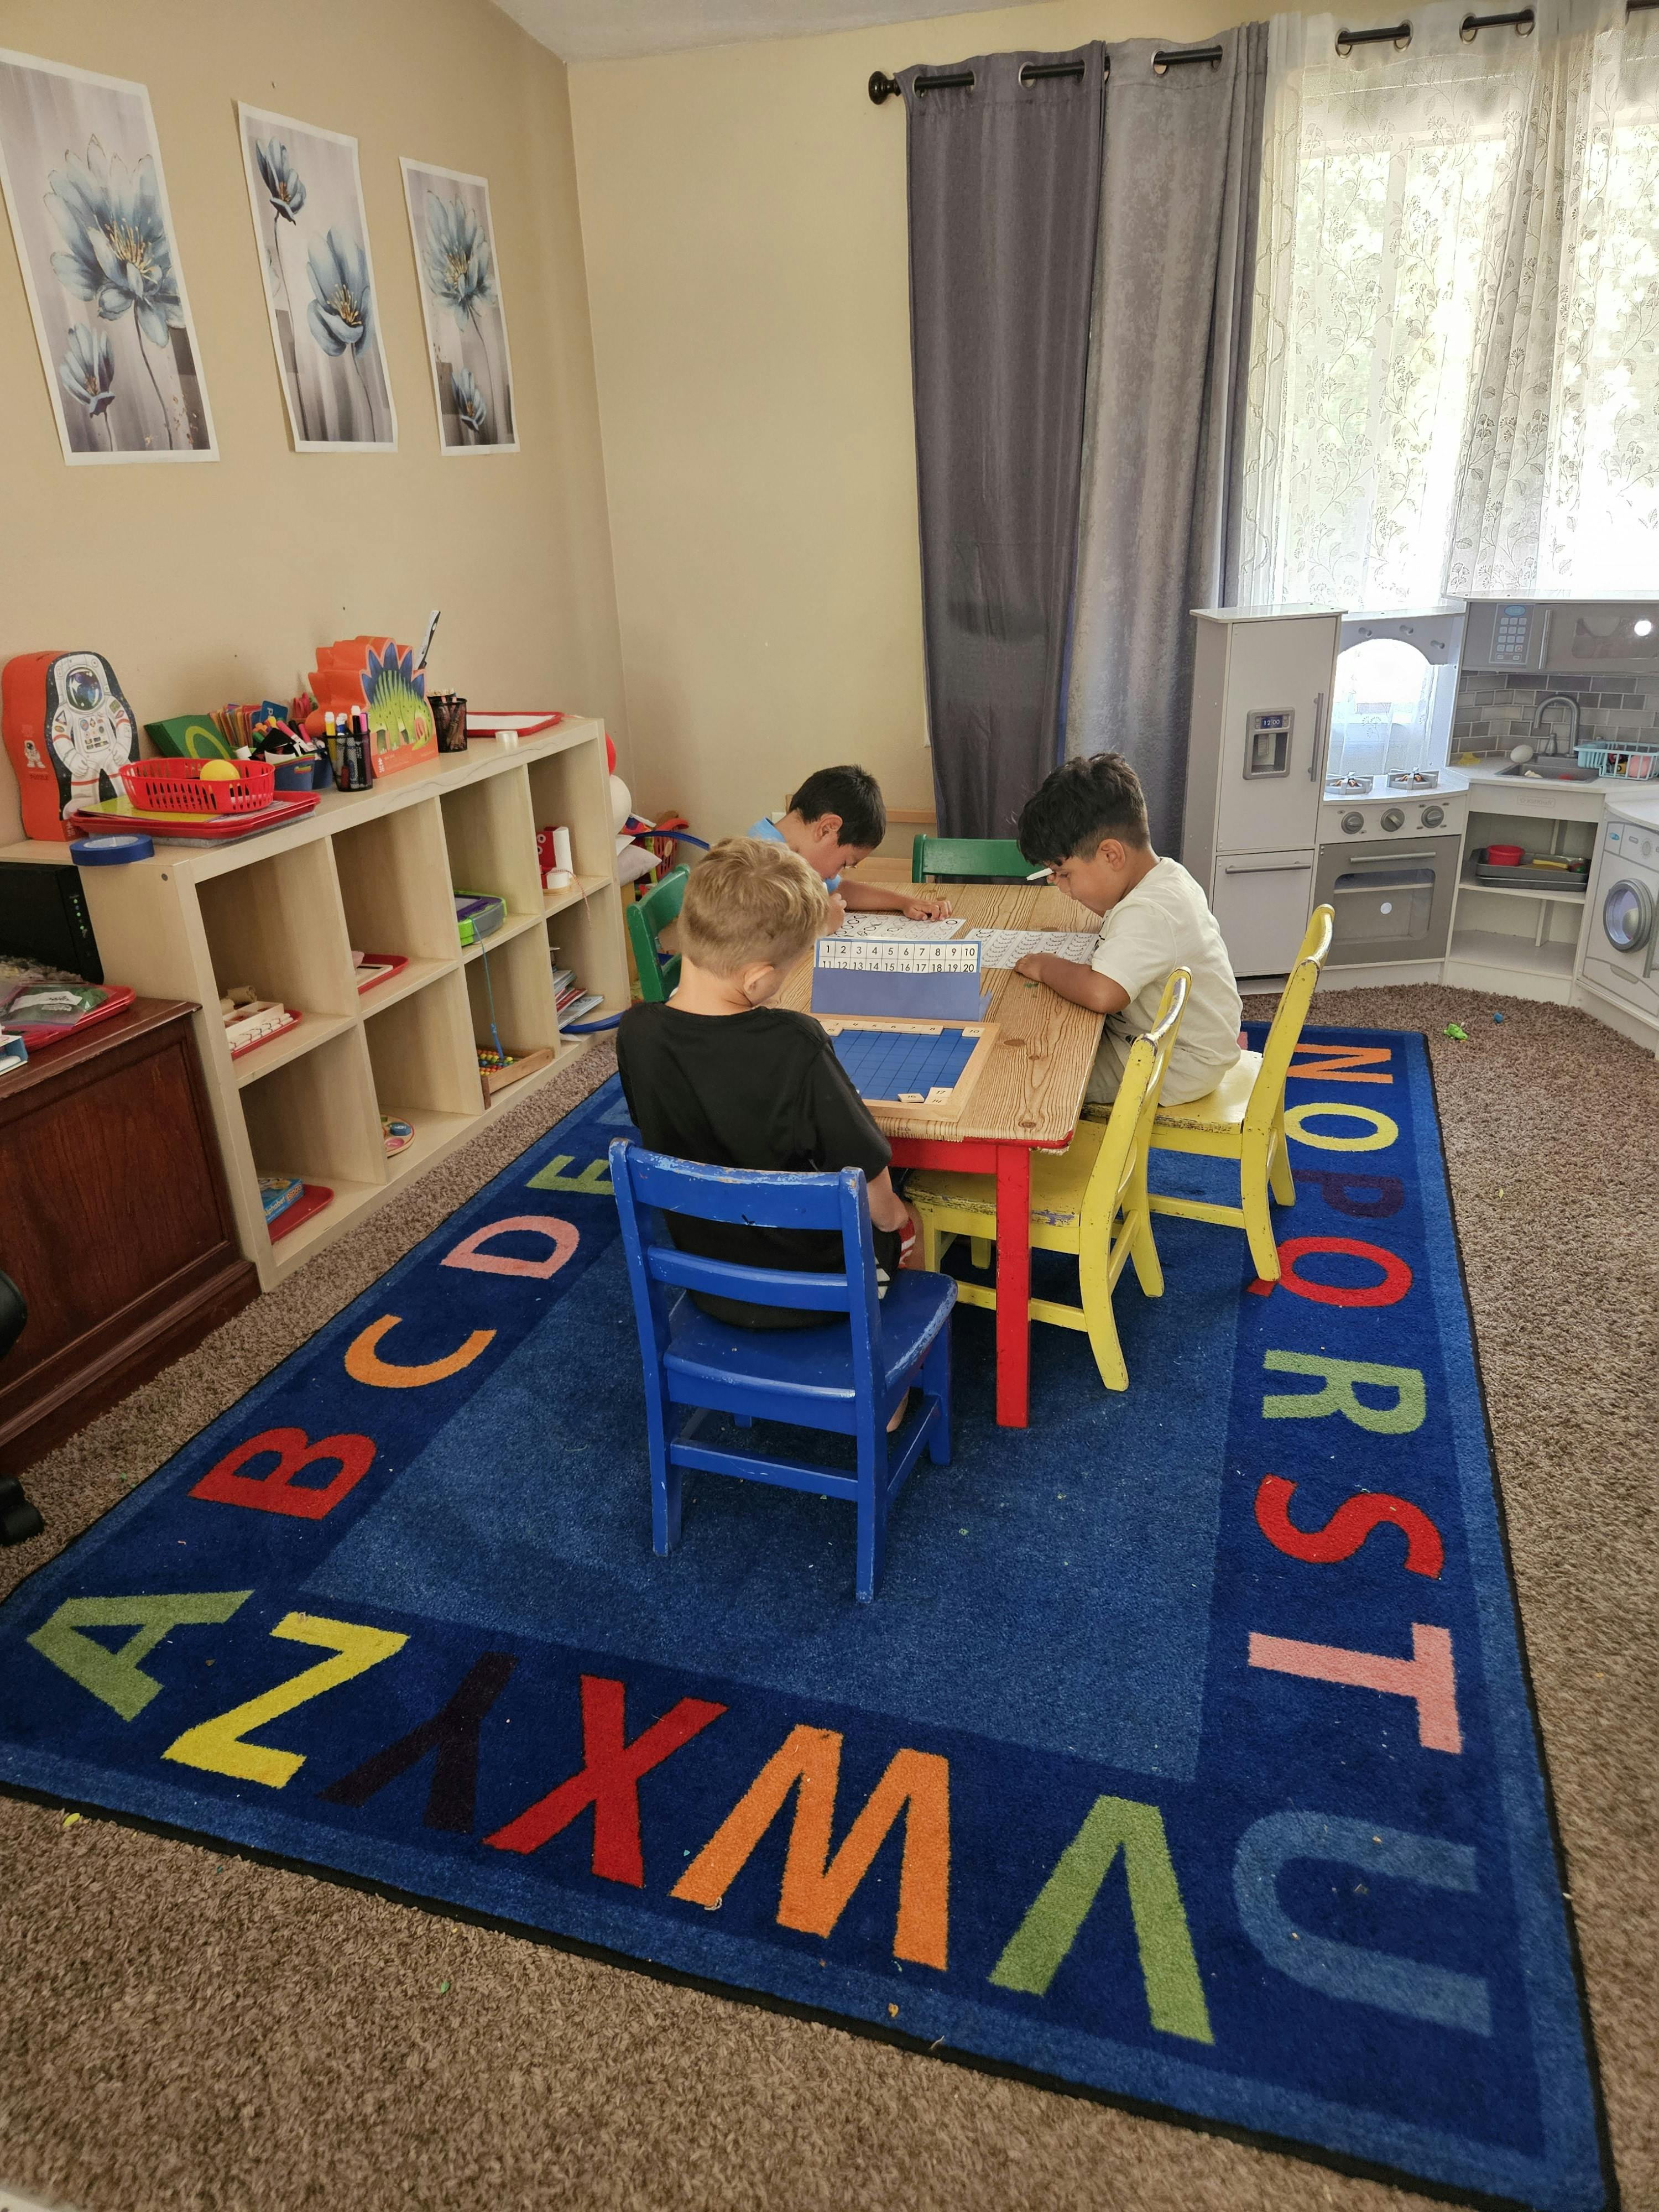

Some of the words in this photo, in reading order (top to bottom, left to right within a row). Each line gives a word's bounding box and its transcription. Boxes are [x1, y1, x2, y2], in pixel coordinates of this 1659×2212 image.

[932, 964, 942, 972] 18
[963, 964, 974, 972] 20
[1284, 1103, 1399, 1152] O
[1286, 1044, 1393, 1084] N
[1292, 1170, 1404, 1218] P
[1247, 1237, 1413, 1307] Q
[1262, 1349, 1427, 1434] R
[28, 1589, 254, 1721] A
[188, 1427, 377, 1521] B
[344, 1313, 497, 1389] C
[440, 1215, 580, 1279] D
[1254, 1473, 1445, 1580] S
[160, 1611, 410, 1790] Z
[317, 1652, 519, 1834] Y
[1248, 1623, 1463, 1754] T
[482, 1674, 729, 1888] X
[670, 1724, 951, 1971] W
[990, 1795, 1215, 2045] V
[1234, 1811, 1494, 2038] U
